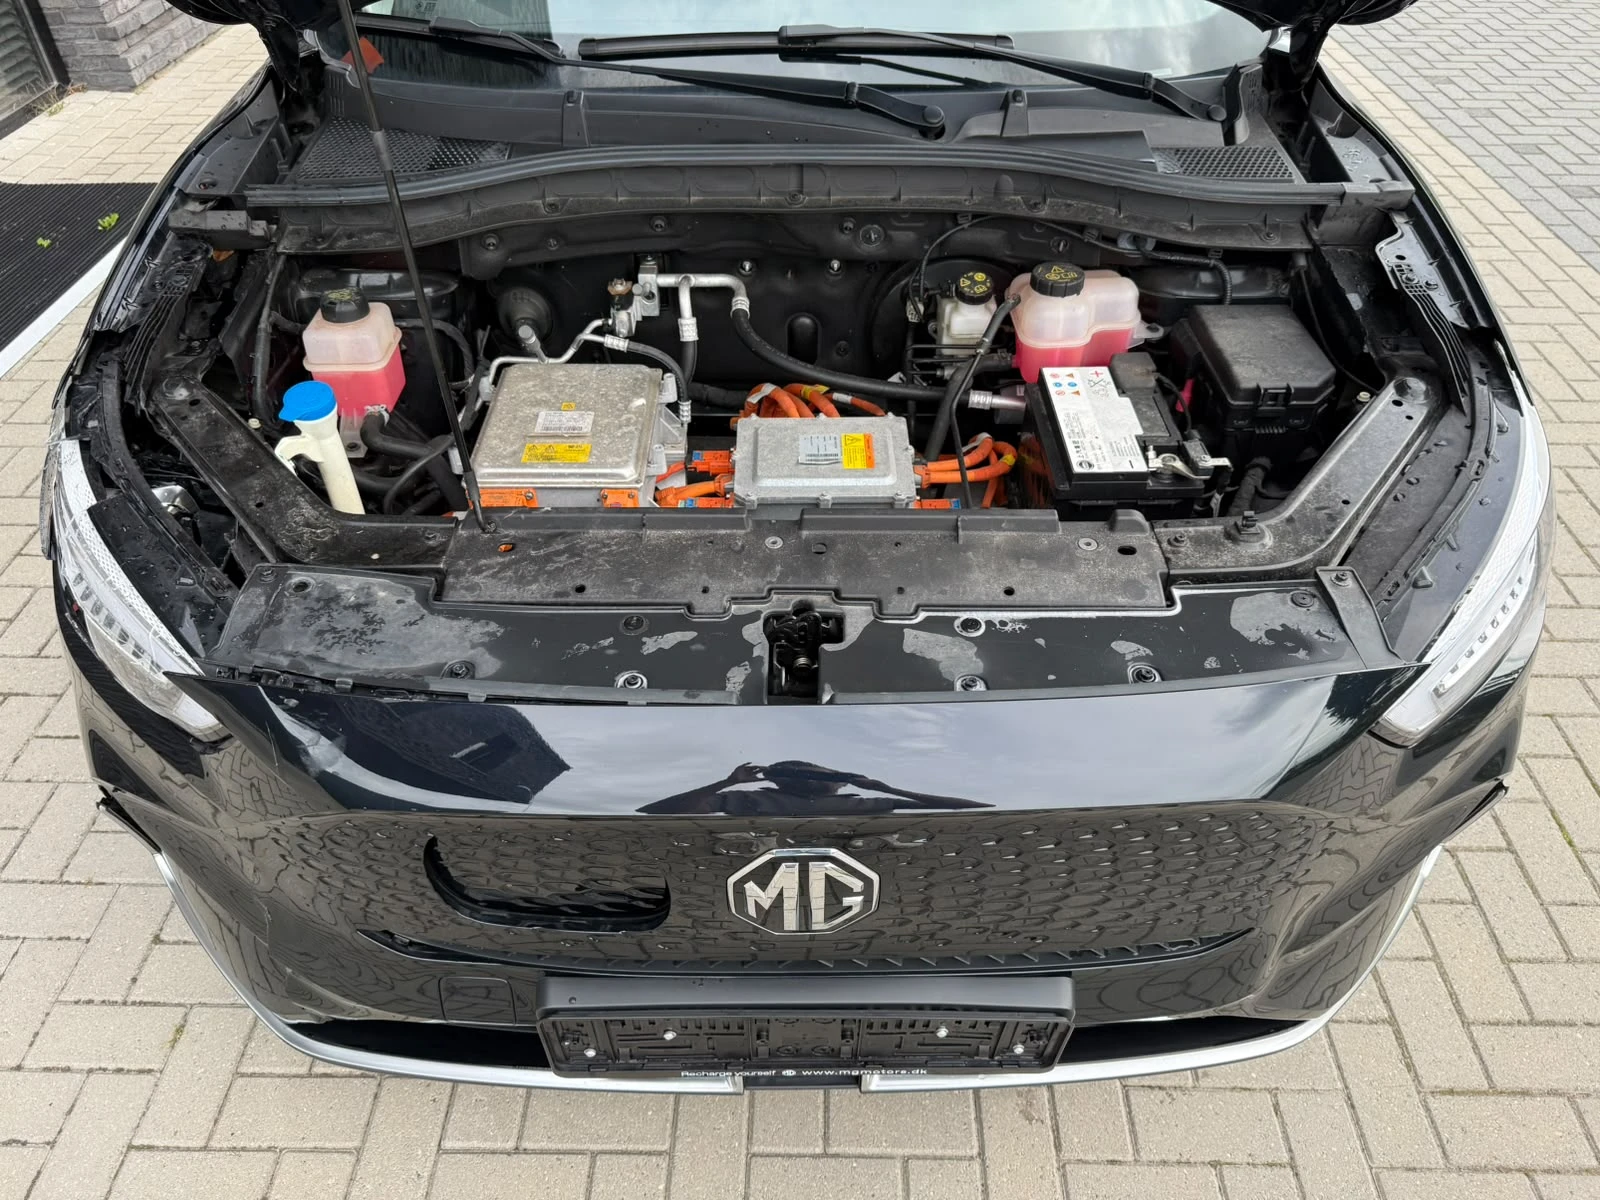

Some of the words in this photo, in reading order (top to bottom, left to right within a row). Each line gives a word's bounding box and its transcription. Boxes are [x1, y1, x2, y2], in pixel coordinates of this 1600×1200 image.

[743, 861, 865, 931] MG
[734, 1069, 777, 1077] yourself
[801, 1068, 928, 1076] www.mgmotors.dk
